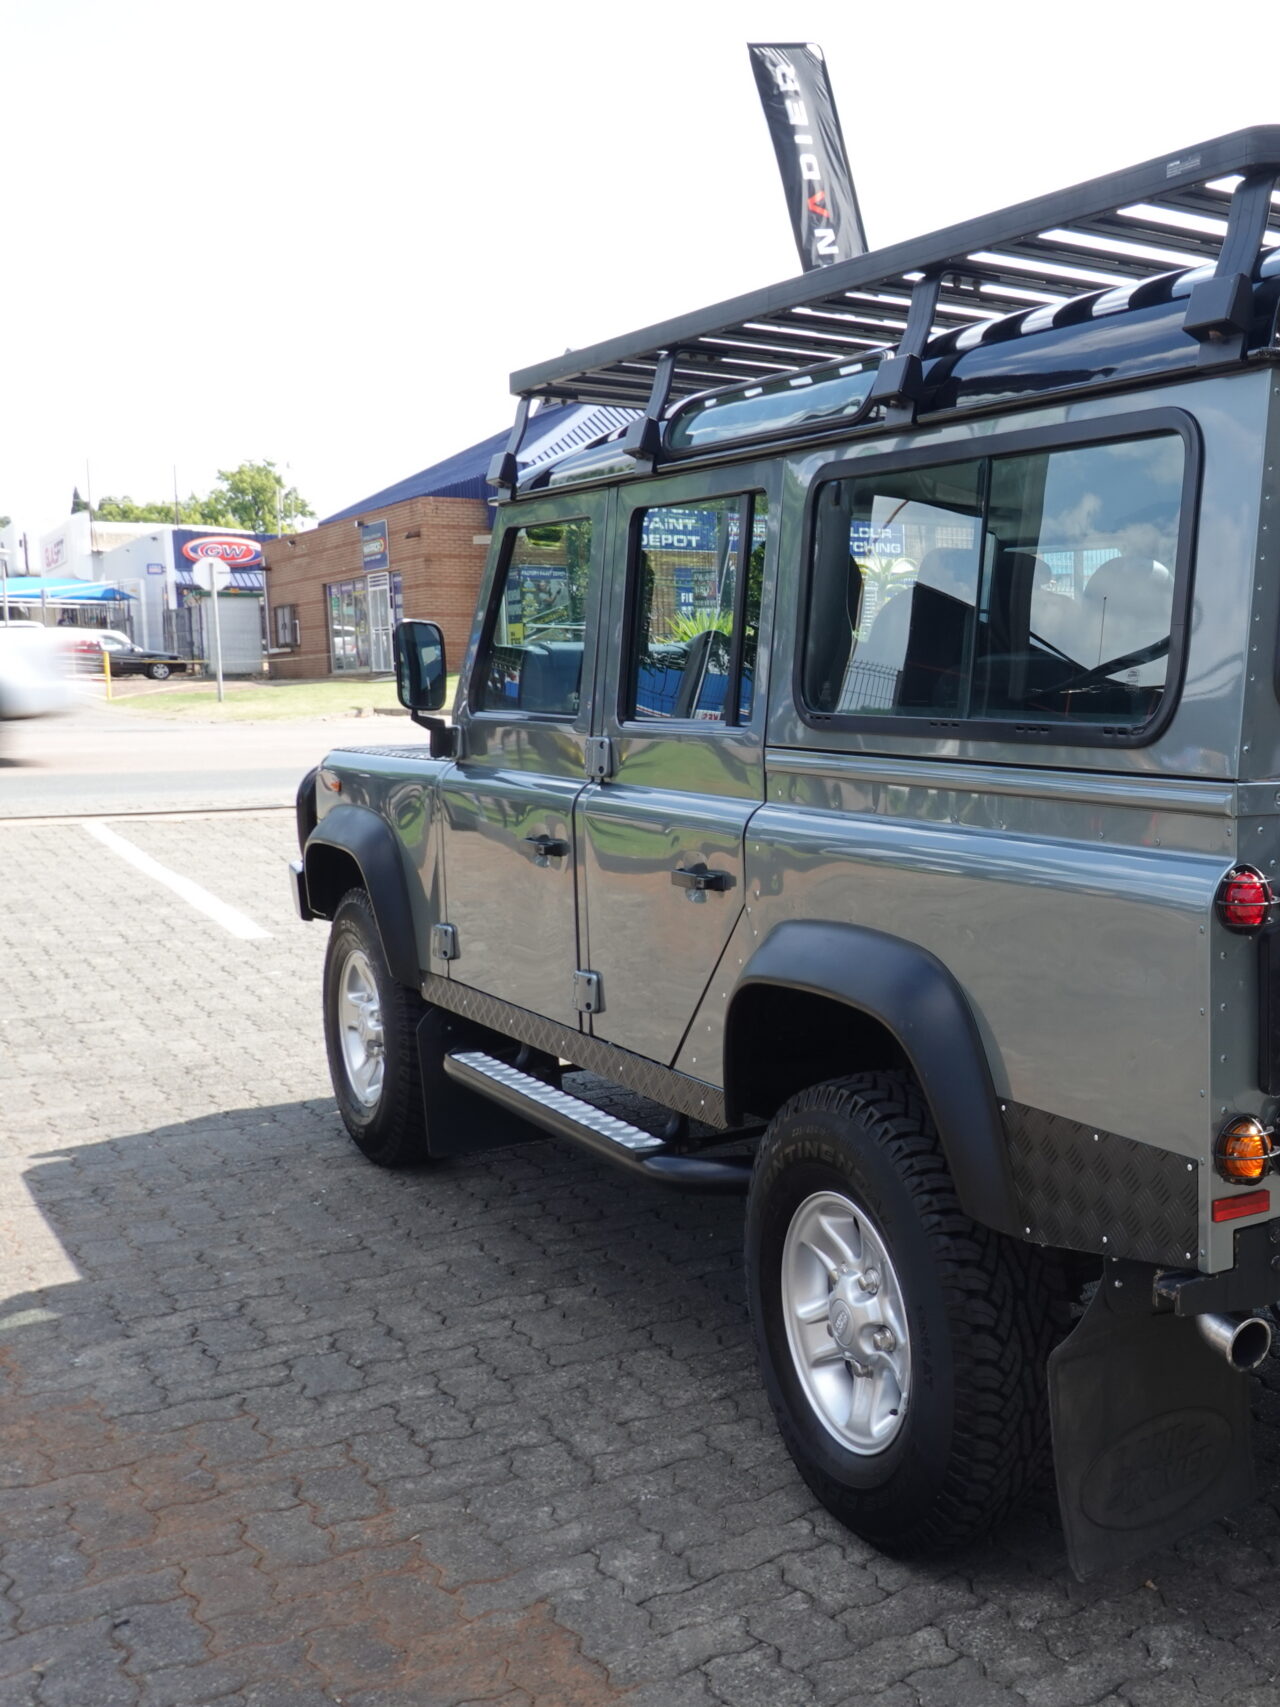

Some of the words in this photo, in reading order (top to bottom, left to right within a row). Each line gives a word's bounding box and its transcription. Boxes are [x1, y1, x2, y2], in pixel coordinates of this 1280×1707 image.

[775, 63, 840, 257] NADIER
[203, 543, 247, 558] GW
[850, 541, 902, 554] CHING
